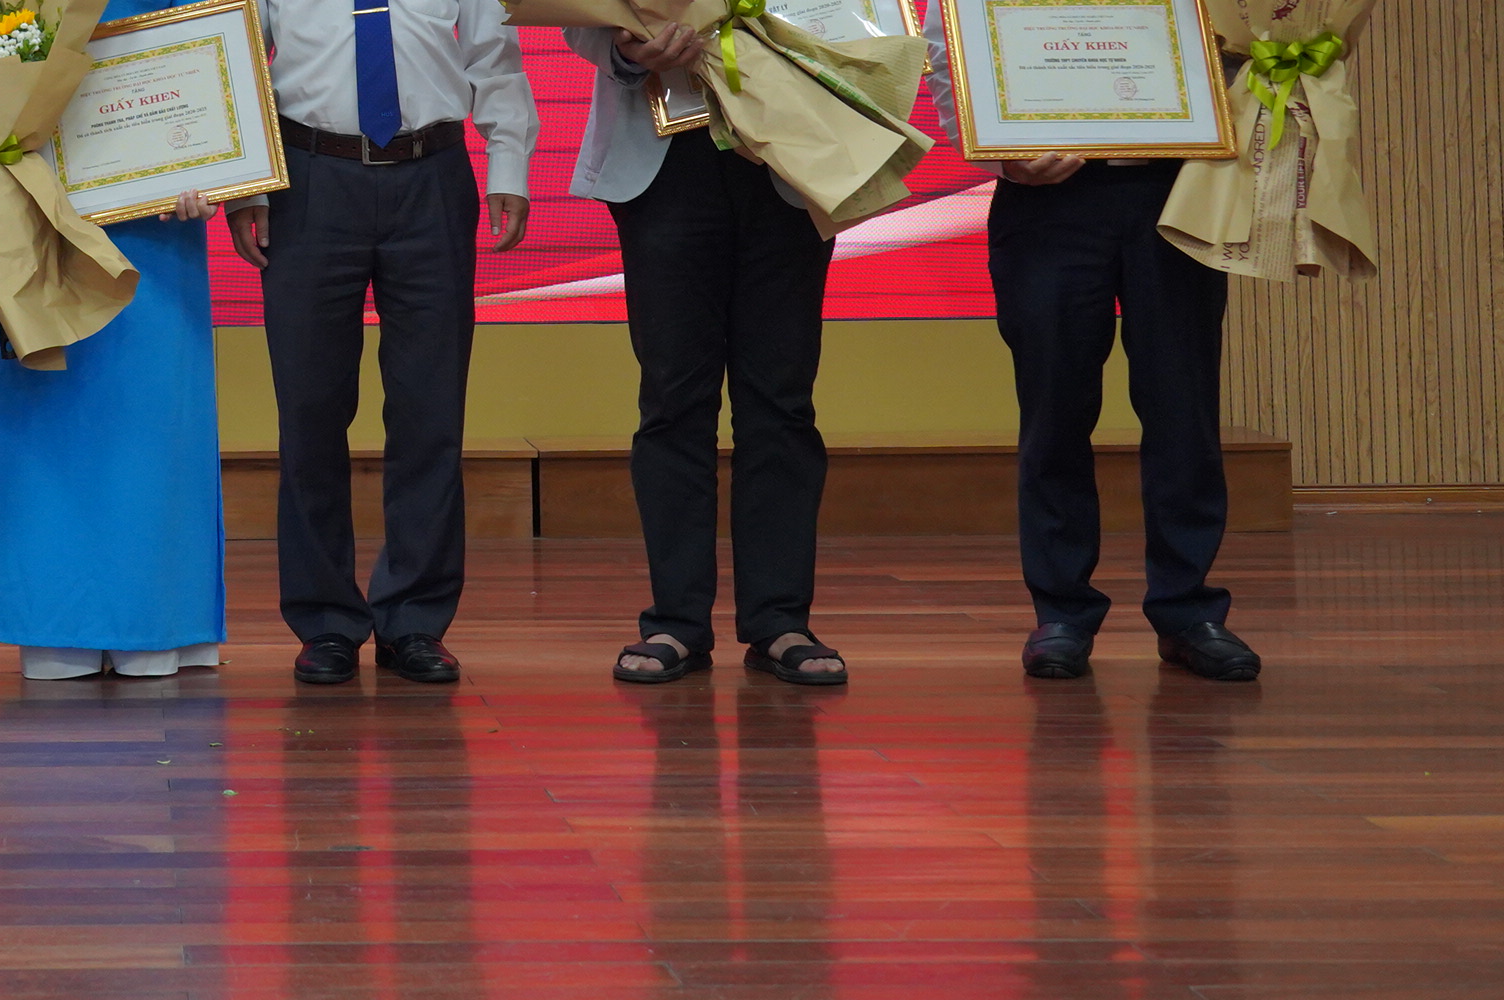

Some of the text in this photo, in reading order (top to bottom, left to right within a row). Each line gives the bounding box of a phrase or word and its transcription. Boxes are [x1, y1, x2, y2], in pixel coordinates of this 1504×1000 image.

[1043, 38, 1129, 51] GIẤY KHEN
[99, 89, 181, 115] GIẤY KHEN
